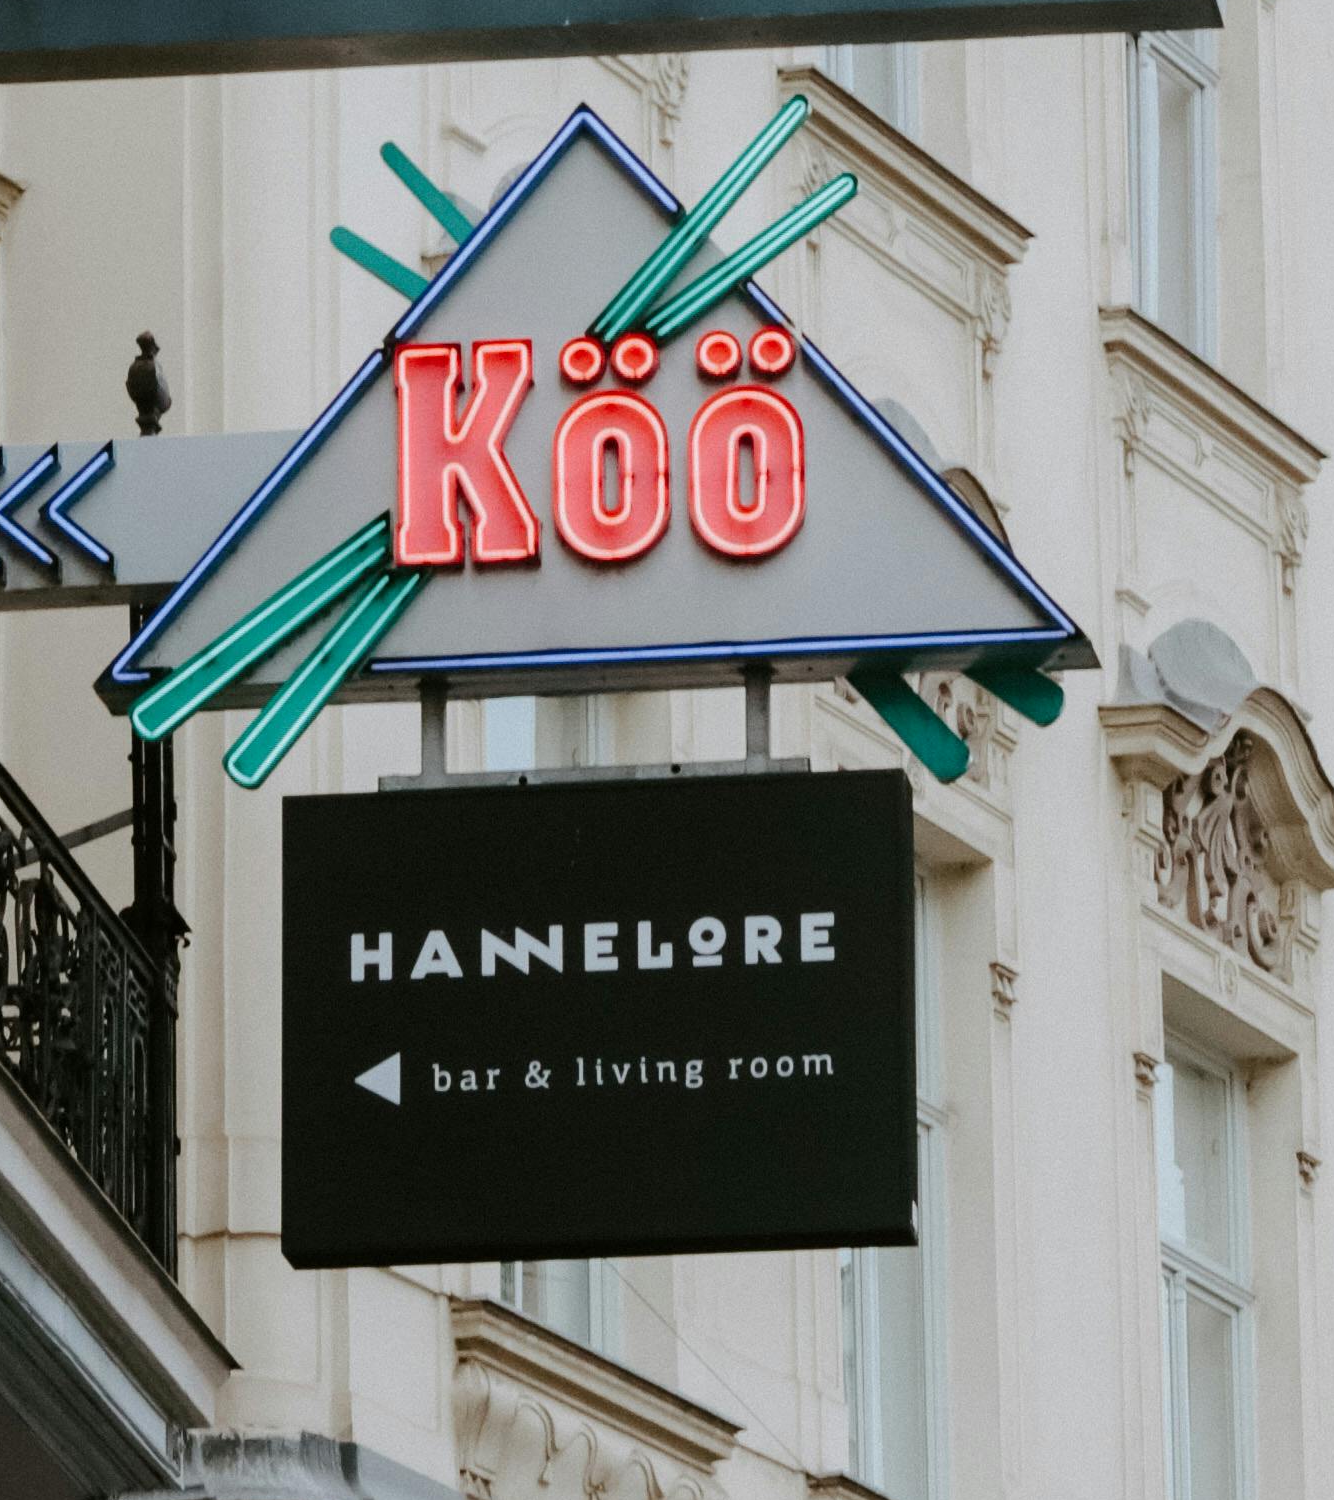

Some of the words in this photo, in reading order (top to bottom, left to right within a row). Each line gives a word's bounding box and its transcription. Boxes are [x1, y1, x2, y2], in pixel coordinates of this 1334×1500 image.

[351, 911, 836, 981] HANNELORE
[432, 1063, 501, 1092] bar
[524, 1060, 552, 1088] &
[575, 1054, 705, 1089] living
[728, 1050, 835, 1080] room
